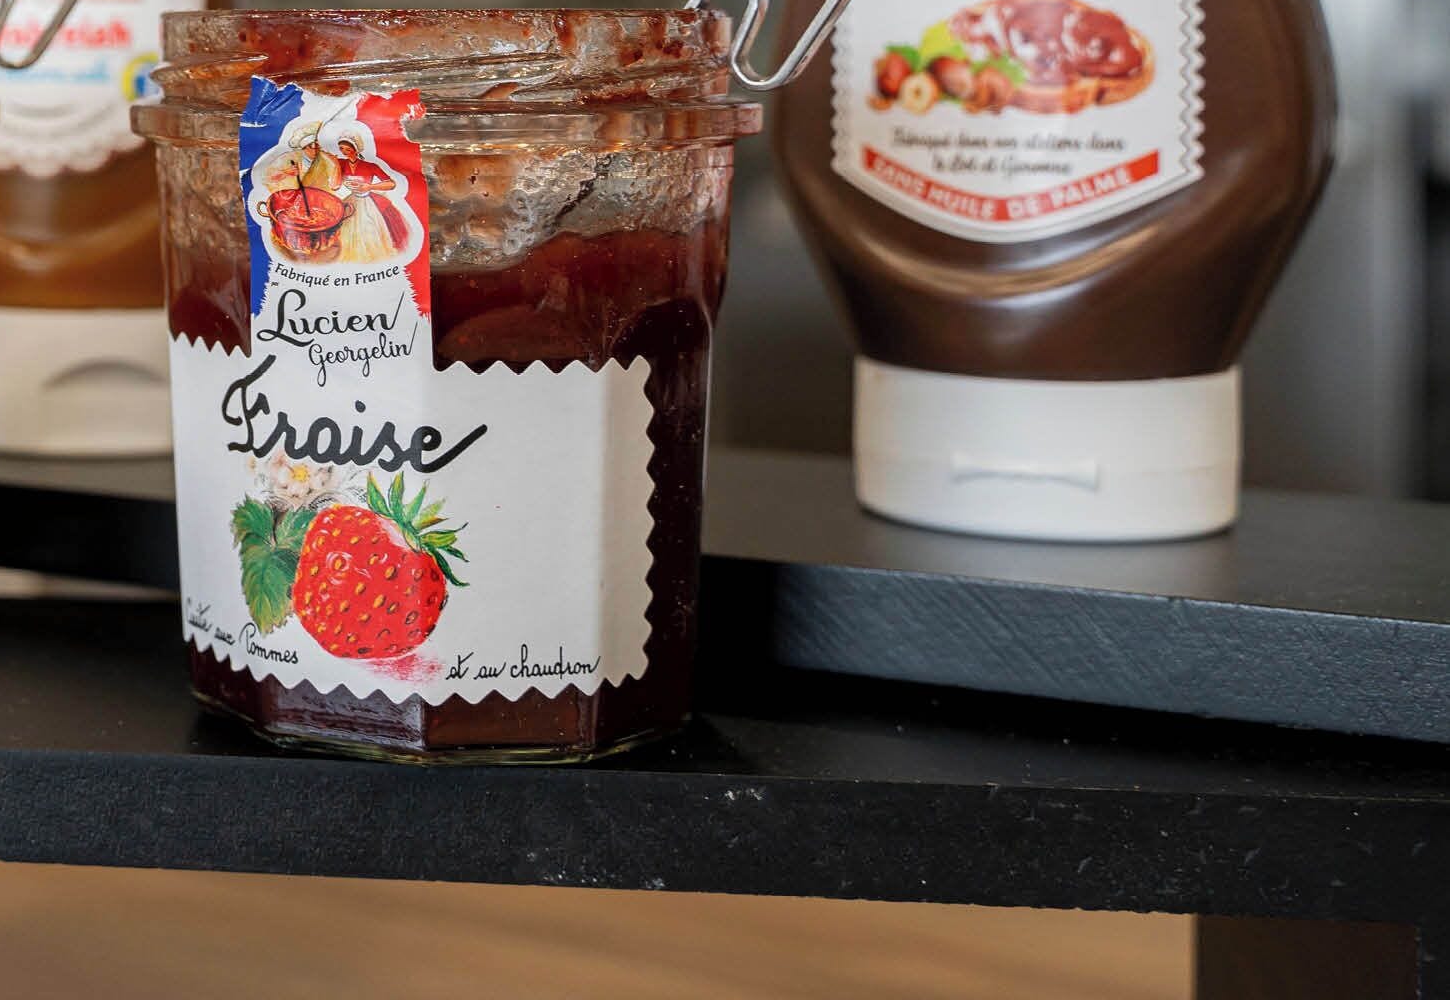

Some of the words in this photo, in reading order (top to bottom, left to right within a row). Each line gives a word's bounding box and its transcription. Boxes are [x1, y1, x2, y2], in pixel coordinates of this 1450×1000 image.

[1049, 166, 1131, 211] PALME
[274, 262, 330, 288] Fabriqué
[333, 276, 350, 287] en
[354, 264, 401, 286] France
[256, 288, 405, 348] Lucien
[308, 321, 419, 388] Georgelin
[221, 354, 488, 474] Fraise
[238, 621, 299, 665] Pommes
[509, 643, 602, 680] chaudron
